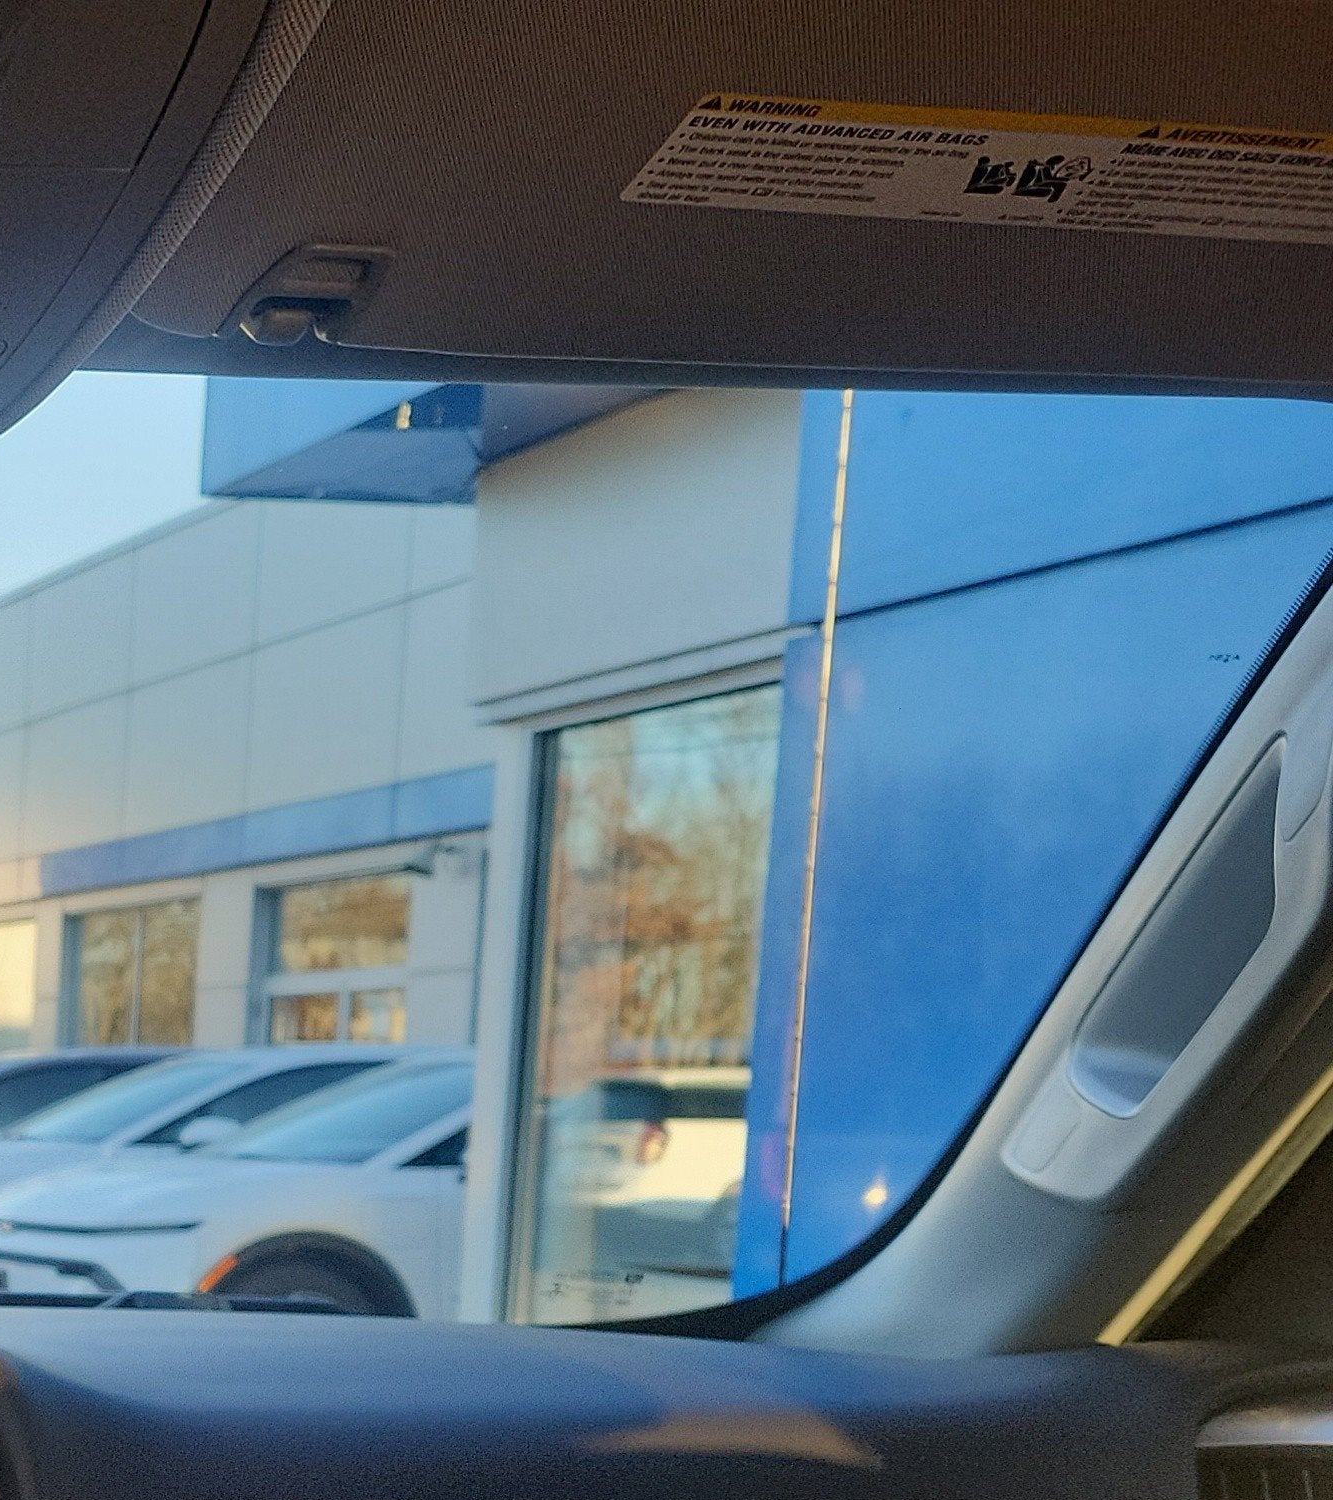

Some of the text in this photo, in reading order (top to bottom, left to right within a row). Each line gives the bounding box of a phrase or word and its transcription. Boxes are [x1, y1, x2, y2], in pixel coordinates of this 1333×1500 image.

[727, 98, 822, 118] WARNING
[688, 116, 989, 146] EVEN WITH ADVANCED AIR BAGS
[1166, 128, 1325, 150] AVERTISSEMENT
